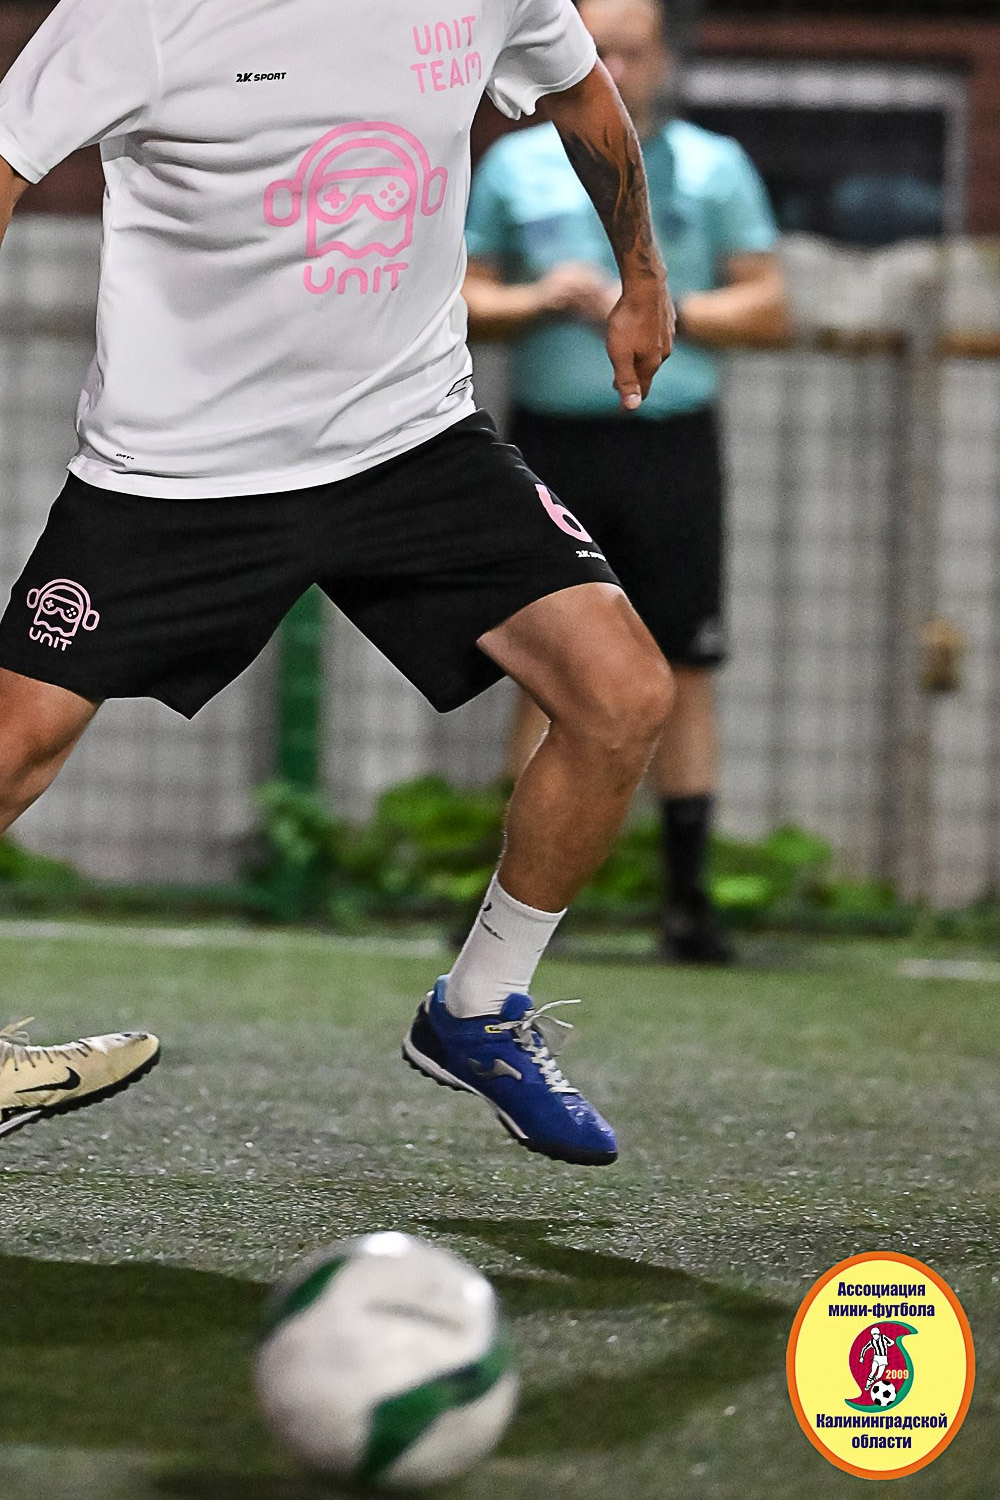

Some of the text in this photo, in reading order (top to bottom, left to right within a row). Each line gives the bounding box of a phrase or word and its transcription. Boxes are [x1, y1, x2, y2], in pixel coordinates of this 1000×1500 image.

[412, 15, 477, 55] UNIT
[235, 72, 287, 83] 2K SPORT
[410, 51, 483, 94] TEAM
[302, 262, 409, 295] UNIT
[534, 483, 593, 543] 6
[28, 626, 72, 651] UNIT
